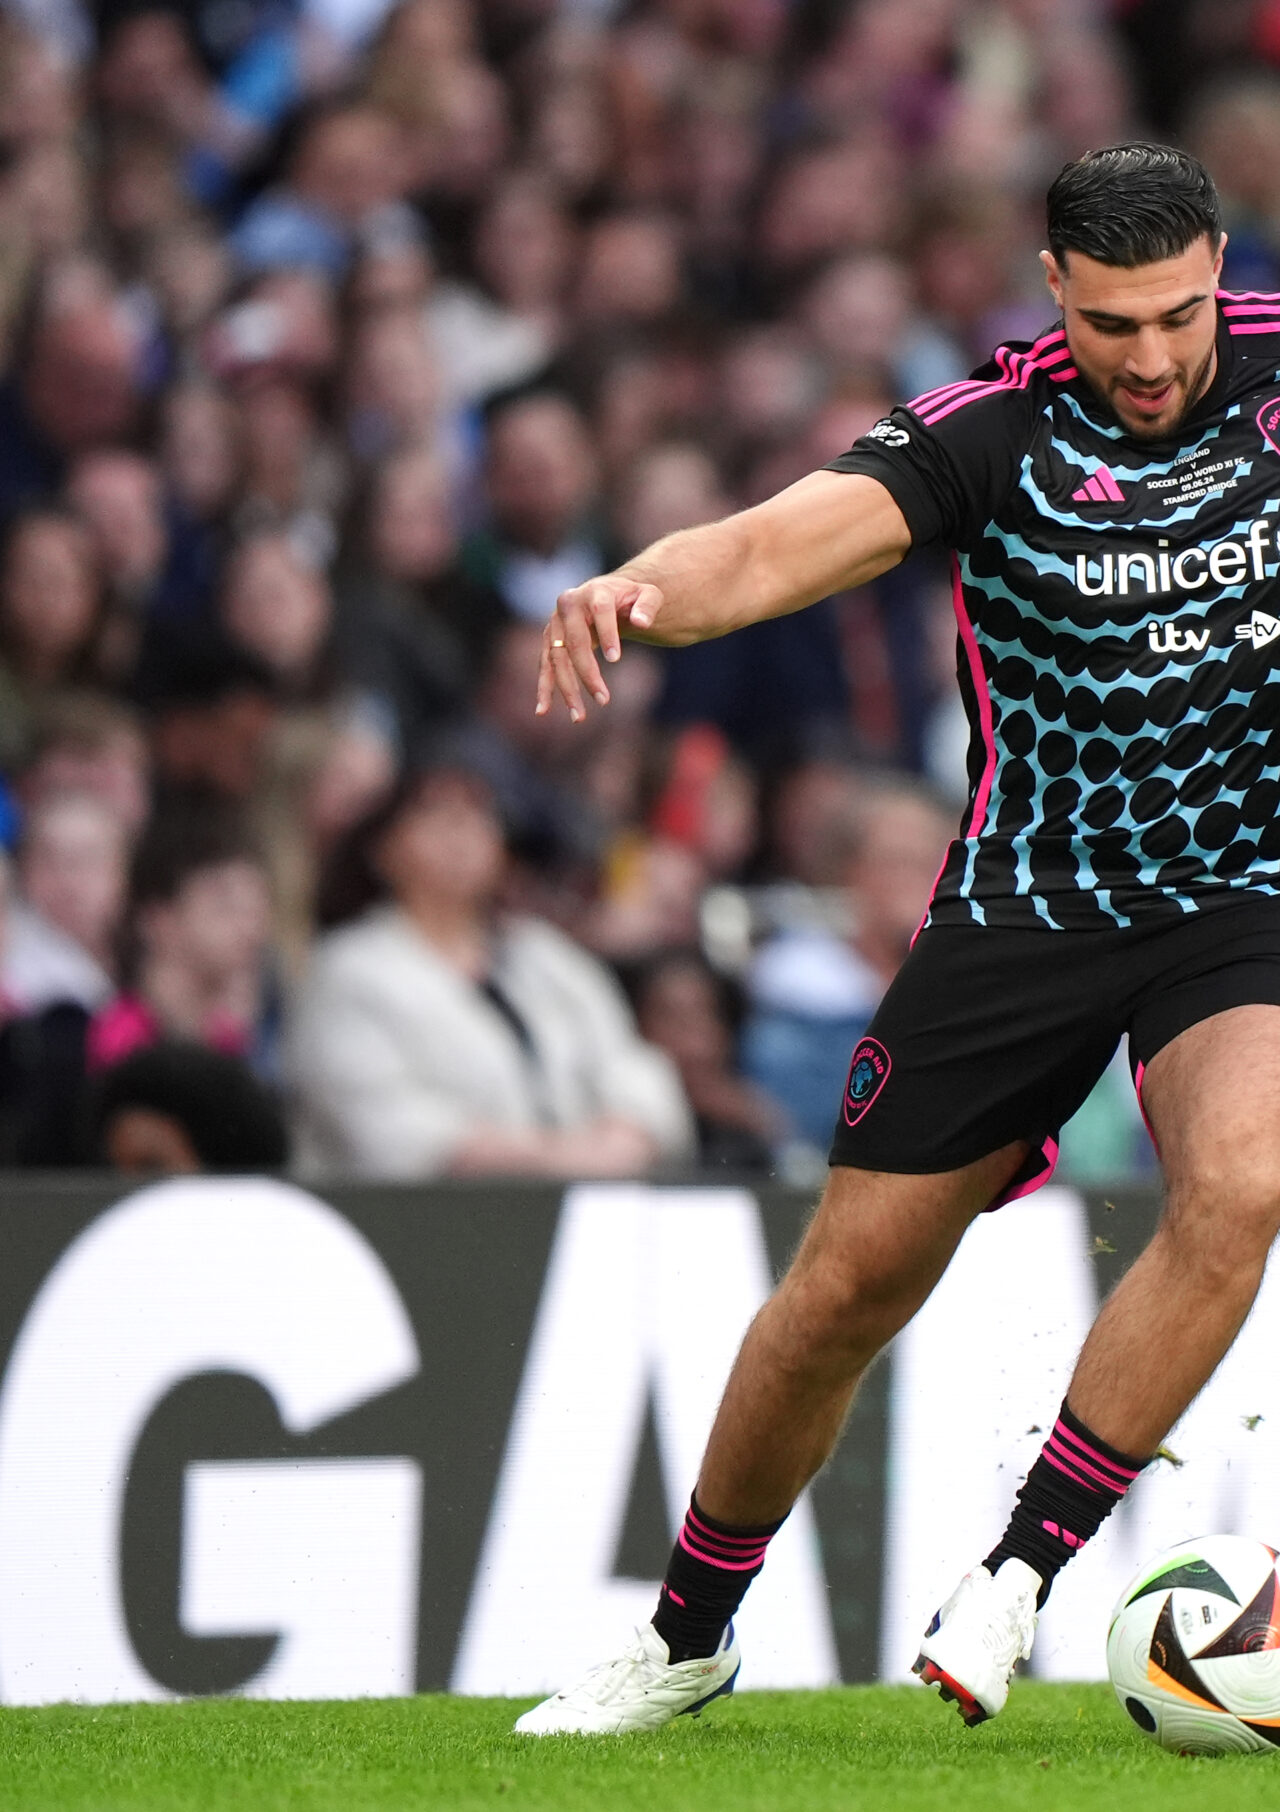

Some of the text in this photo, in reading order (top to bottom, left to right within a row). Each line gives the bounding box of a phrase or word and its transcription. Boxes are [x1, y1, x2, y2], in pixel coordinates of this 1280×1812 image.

[1173, 447, 1211, 467] ENGLAND
[1189, 461, 1197, 470] V
[1146, 456, 1246, 490] SOCCER AID WORLD XI FC
[1181, 475, 1215, 494] 09.06.24
[1162, 479, 1238, 506] STAMFORD BRIDGE
[1075, 518, 1270, 597] unicef
[1147, 620, 1211, 654] itv
